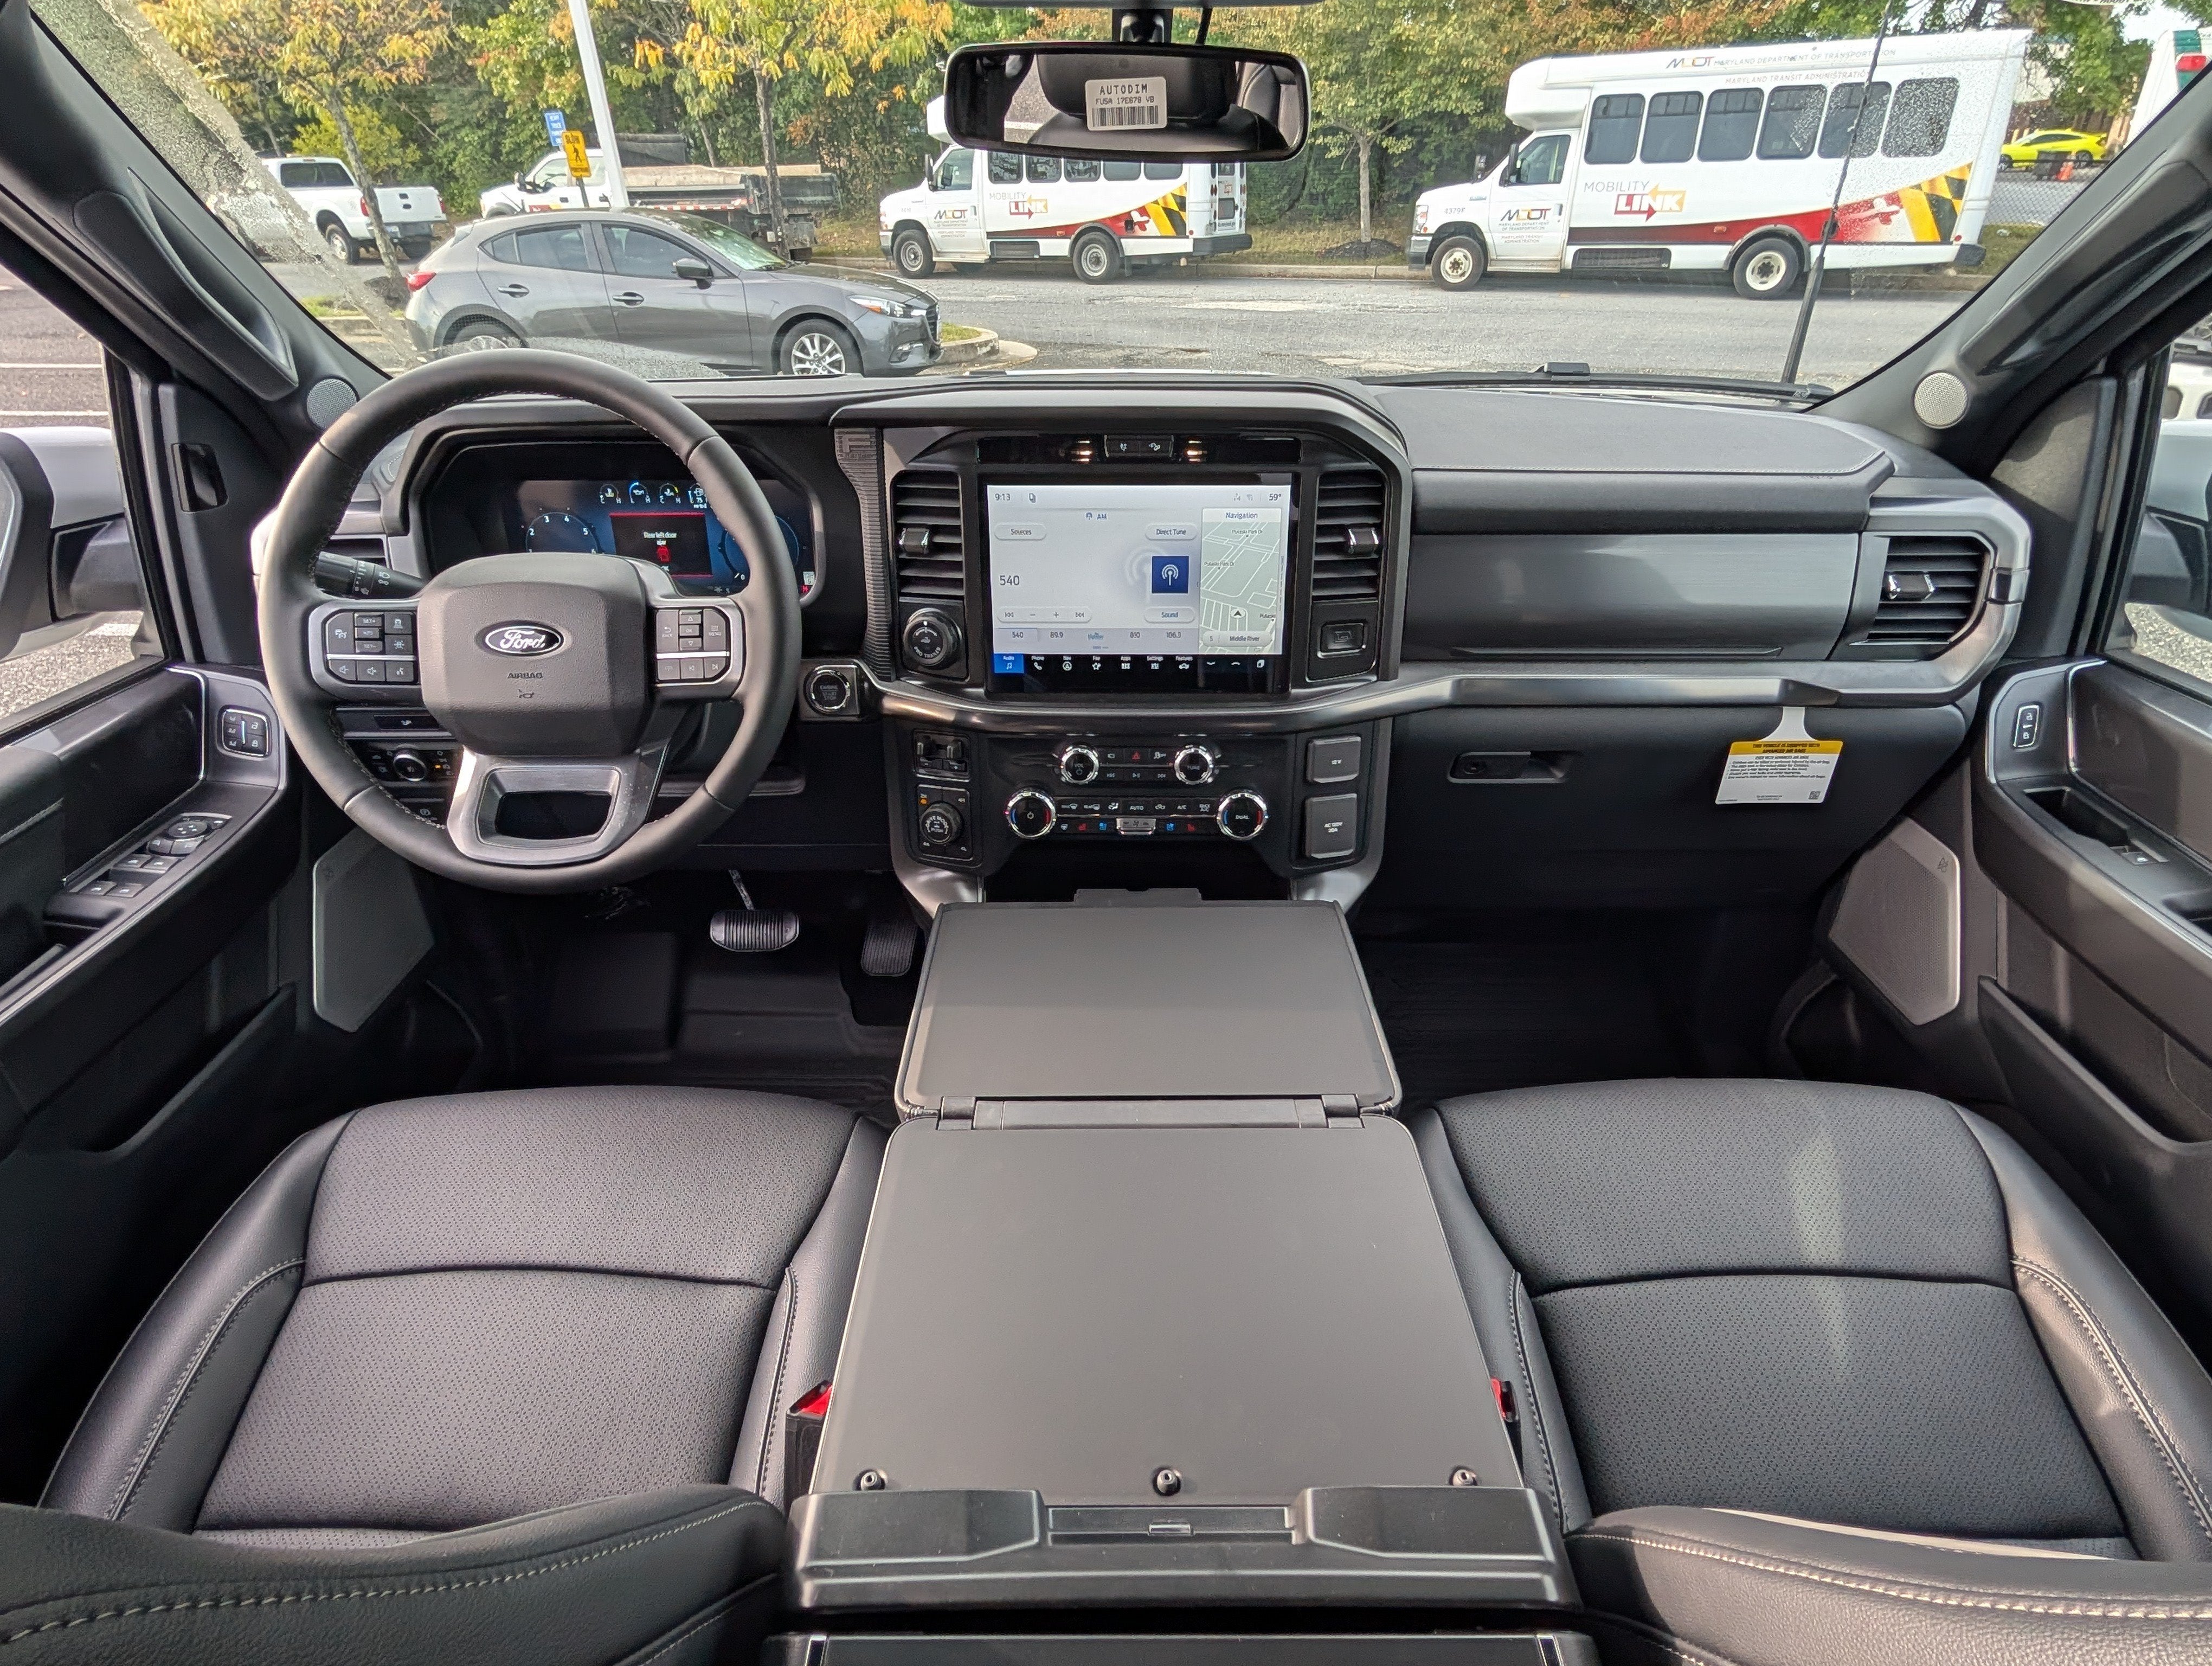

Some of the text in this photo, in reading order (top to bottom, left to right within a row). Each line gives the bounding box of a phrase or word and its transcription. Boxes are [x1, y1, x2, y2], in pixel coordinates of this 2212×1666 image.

[1725, 76, 1767, 84] MARYLAND
[1770, 73, 1802, 81] TRANSIT
[1099, 84, 1148, 95] AUTODIM
[1117, 97, 1142, 105] 17E678
[1584, 180, 1650, 192] MOBILITY
[989, 192, 1026, 200] MOBILITY
[1010, 201, 1047, 213] LINK
[1617, 194, 1683, 212] LINK
[995, 493, 1011, 501] 9:13
[529, 528, 535, 536] 2
[1000, 575, 1020, 586] 540
[500, 630, 545, 649] Ford
